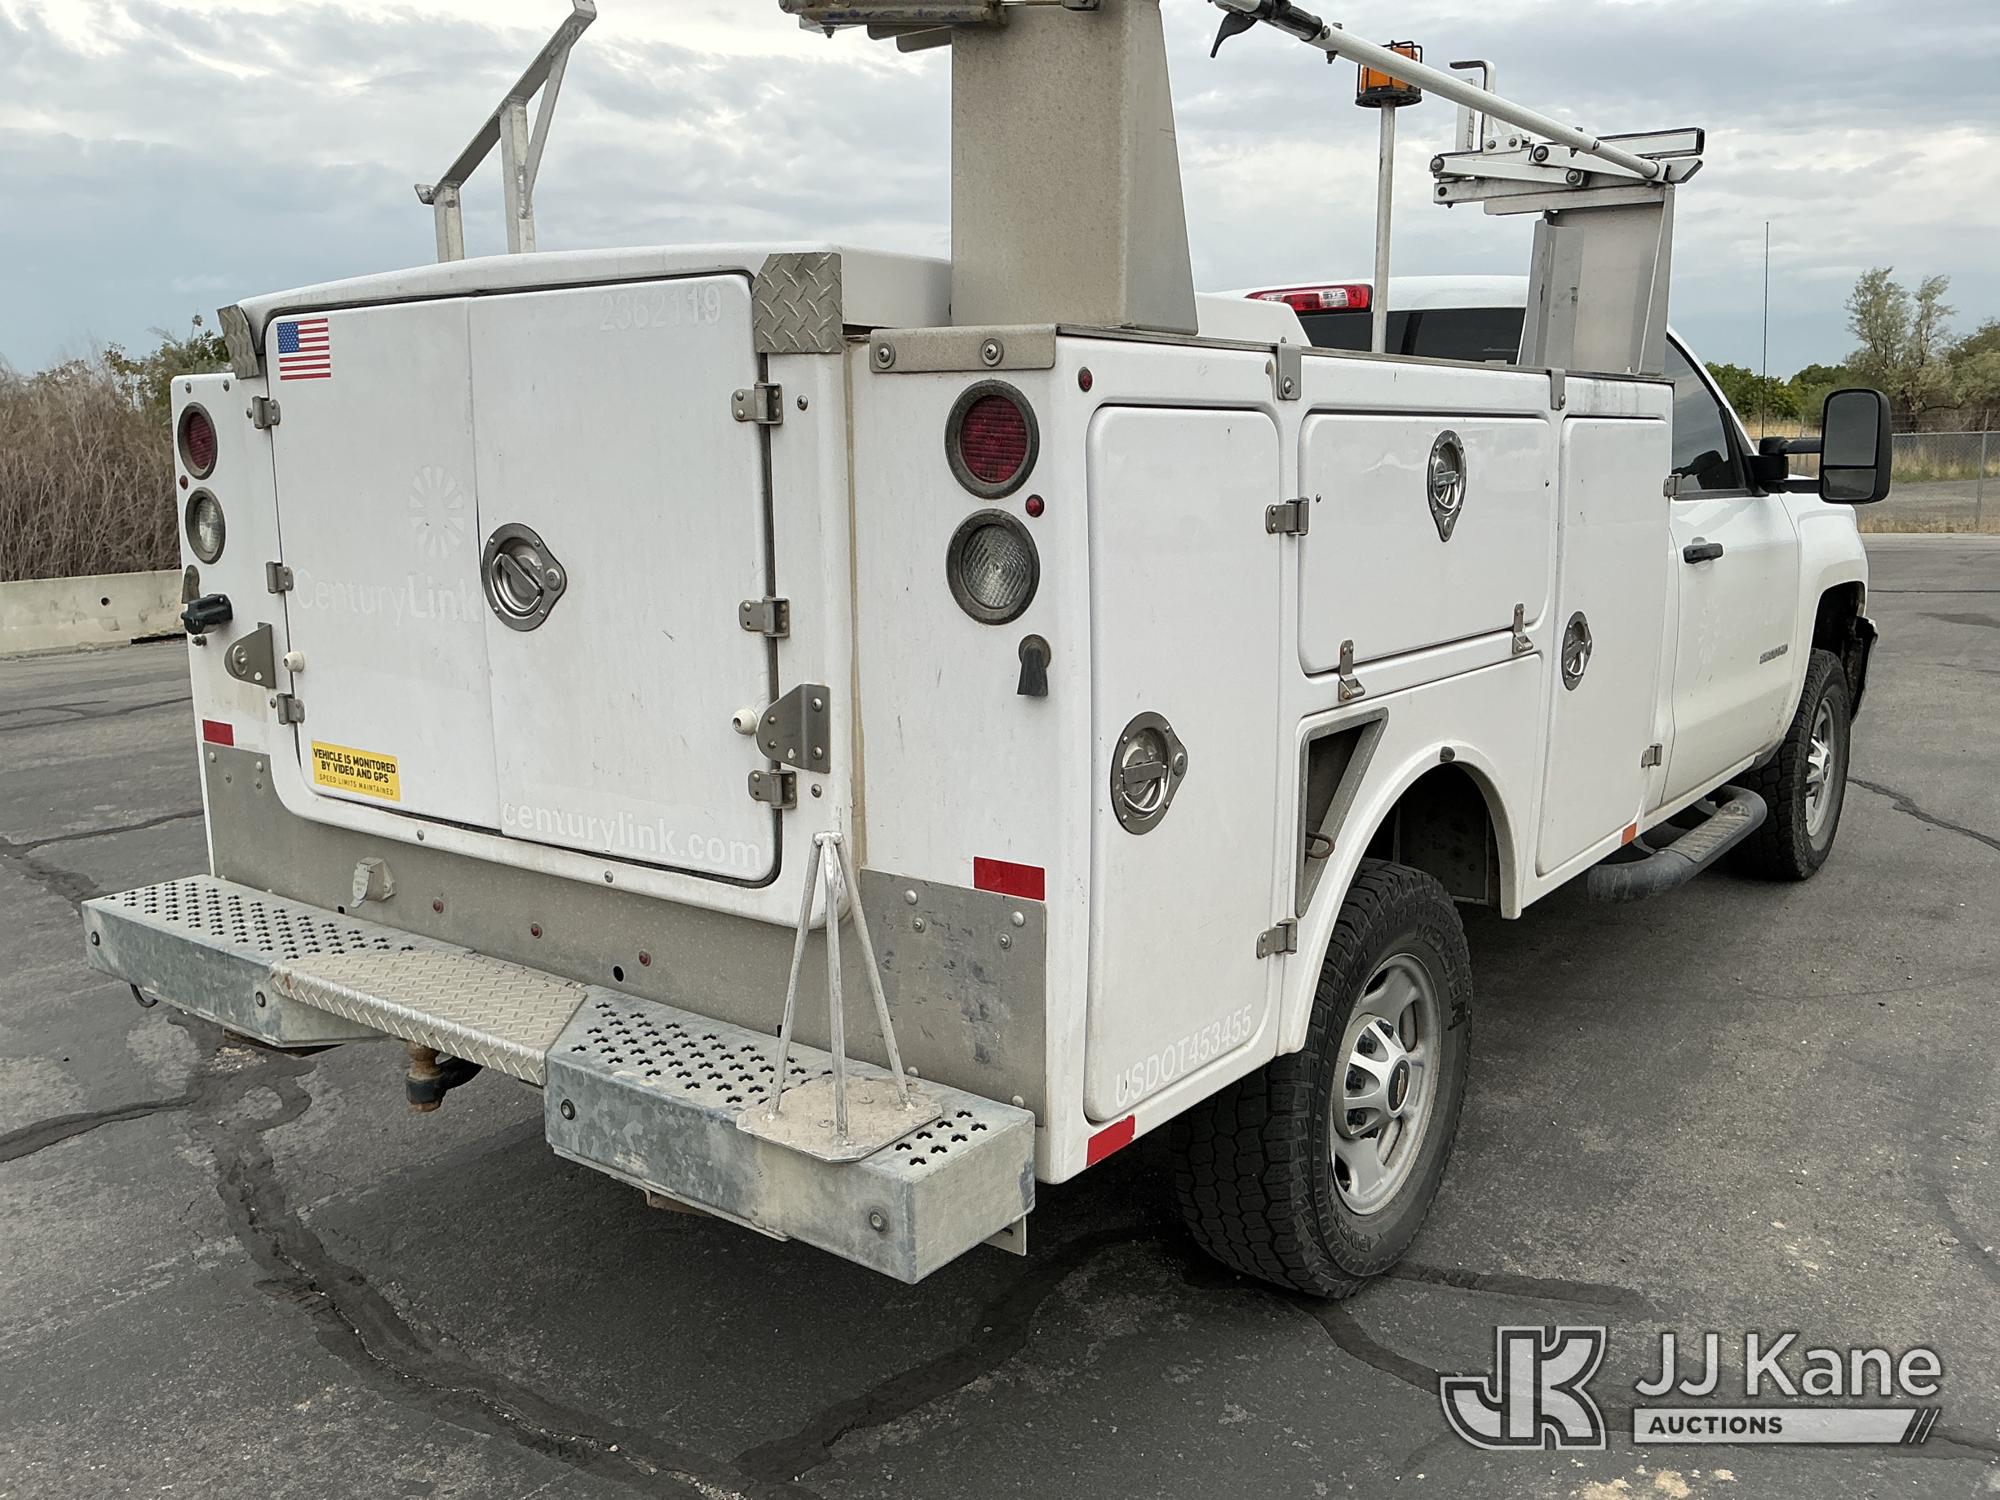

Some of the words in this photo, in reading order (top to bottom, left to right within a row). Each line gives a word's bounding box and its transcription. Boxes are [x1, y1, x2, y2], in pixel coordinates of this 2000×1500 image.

[295, 567, 482, 628] CenturyLink
[313, 748, 342, 763] VEHICLE
[344, 754, 352, 765] IS
[352, 756, 396, 774] MONITORED
[321, 760, 331, 771] BY
[333, 763, 355, 776] VIDEO
[356, 769, 372, 780] AND
[373, 772, 389, 783] GPS
[319, 773, 337, 784] SPEED
[338, 779, 357, 788] LIMITS
[359, 782, 394, 796] MAINTAINED
[502, 802, 761, 871] centurylink.com
